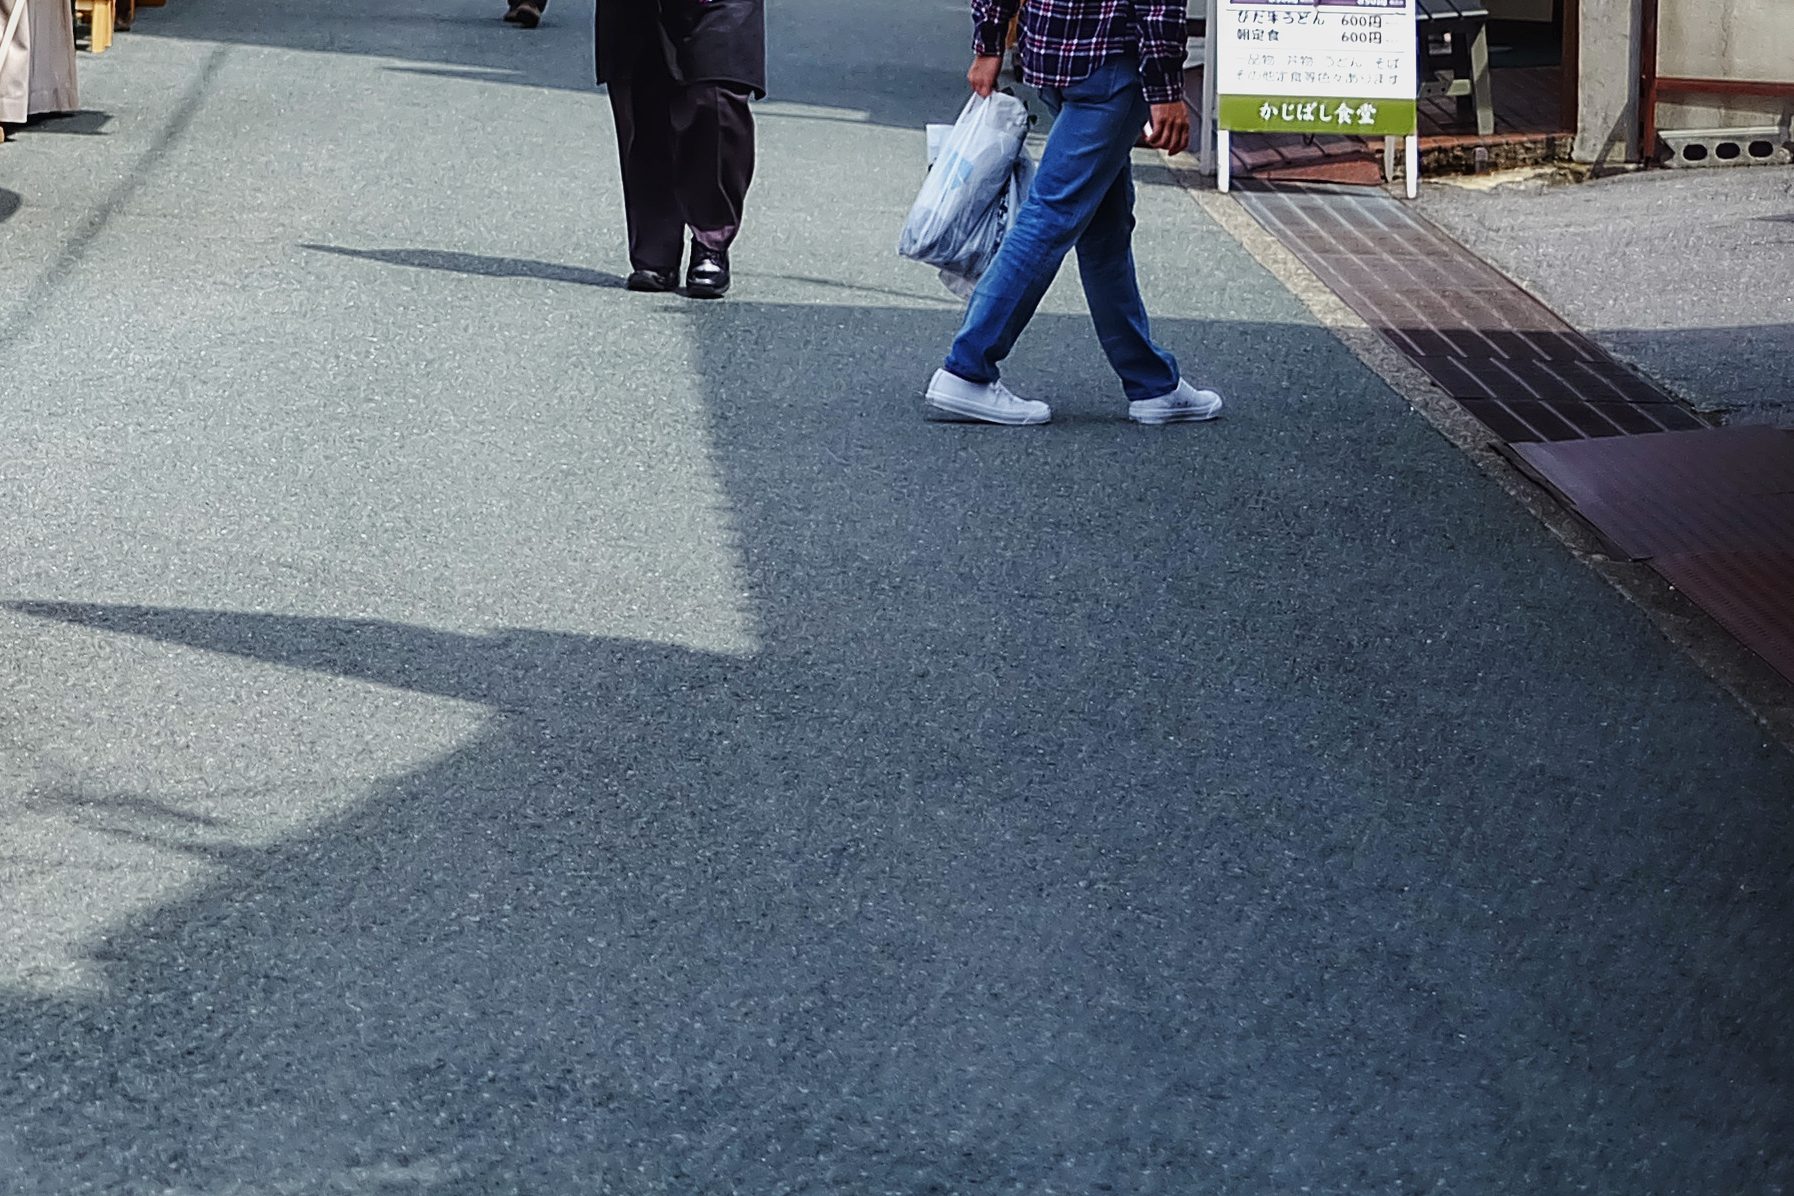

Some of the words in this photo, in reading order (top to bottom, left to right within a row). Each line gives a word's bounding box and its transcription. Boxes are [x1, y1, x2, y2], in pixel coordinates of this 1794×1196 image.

[1341, 15, 1382, 28] 600円
[1237, 28, 1280, 42] 朝定食
[1341, 31, 1382, 44] 600円
[1259, 102, 1377, 125] かじばし食堂
